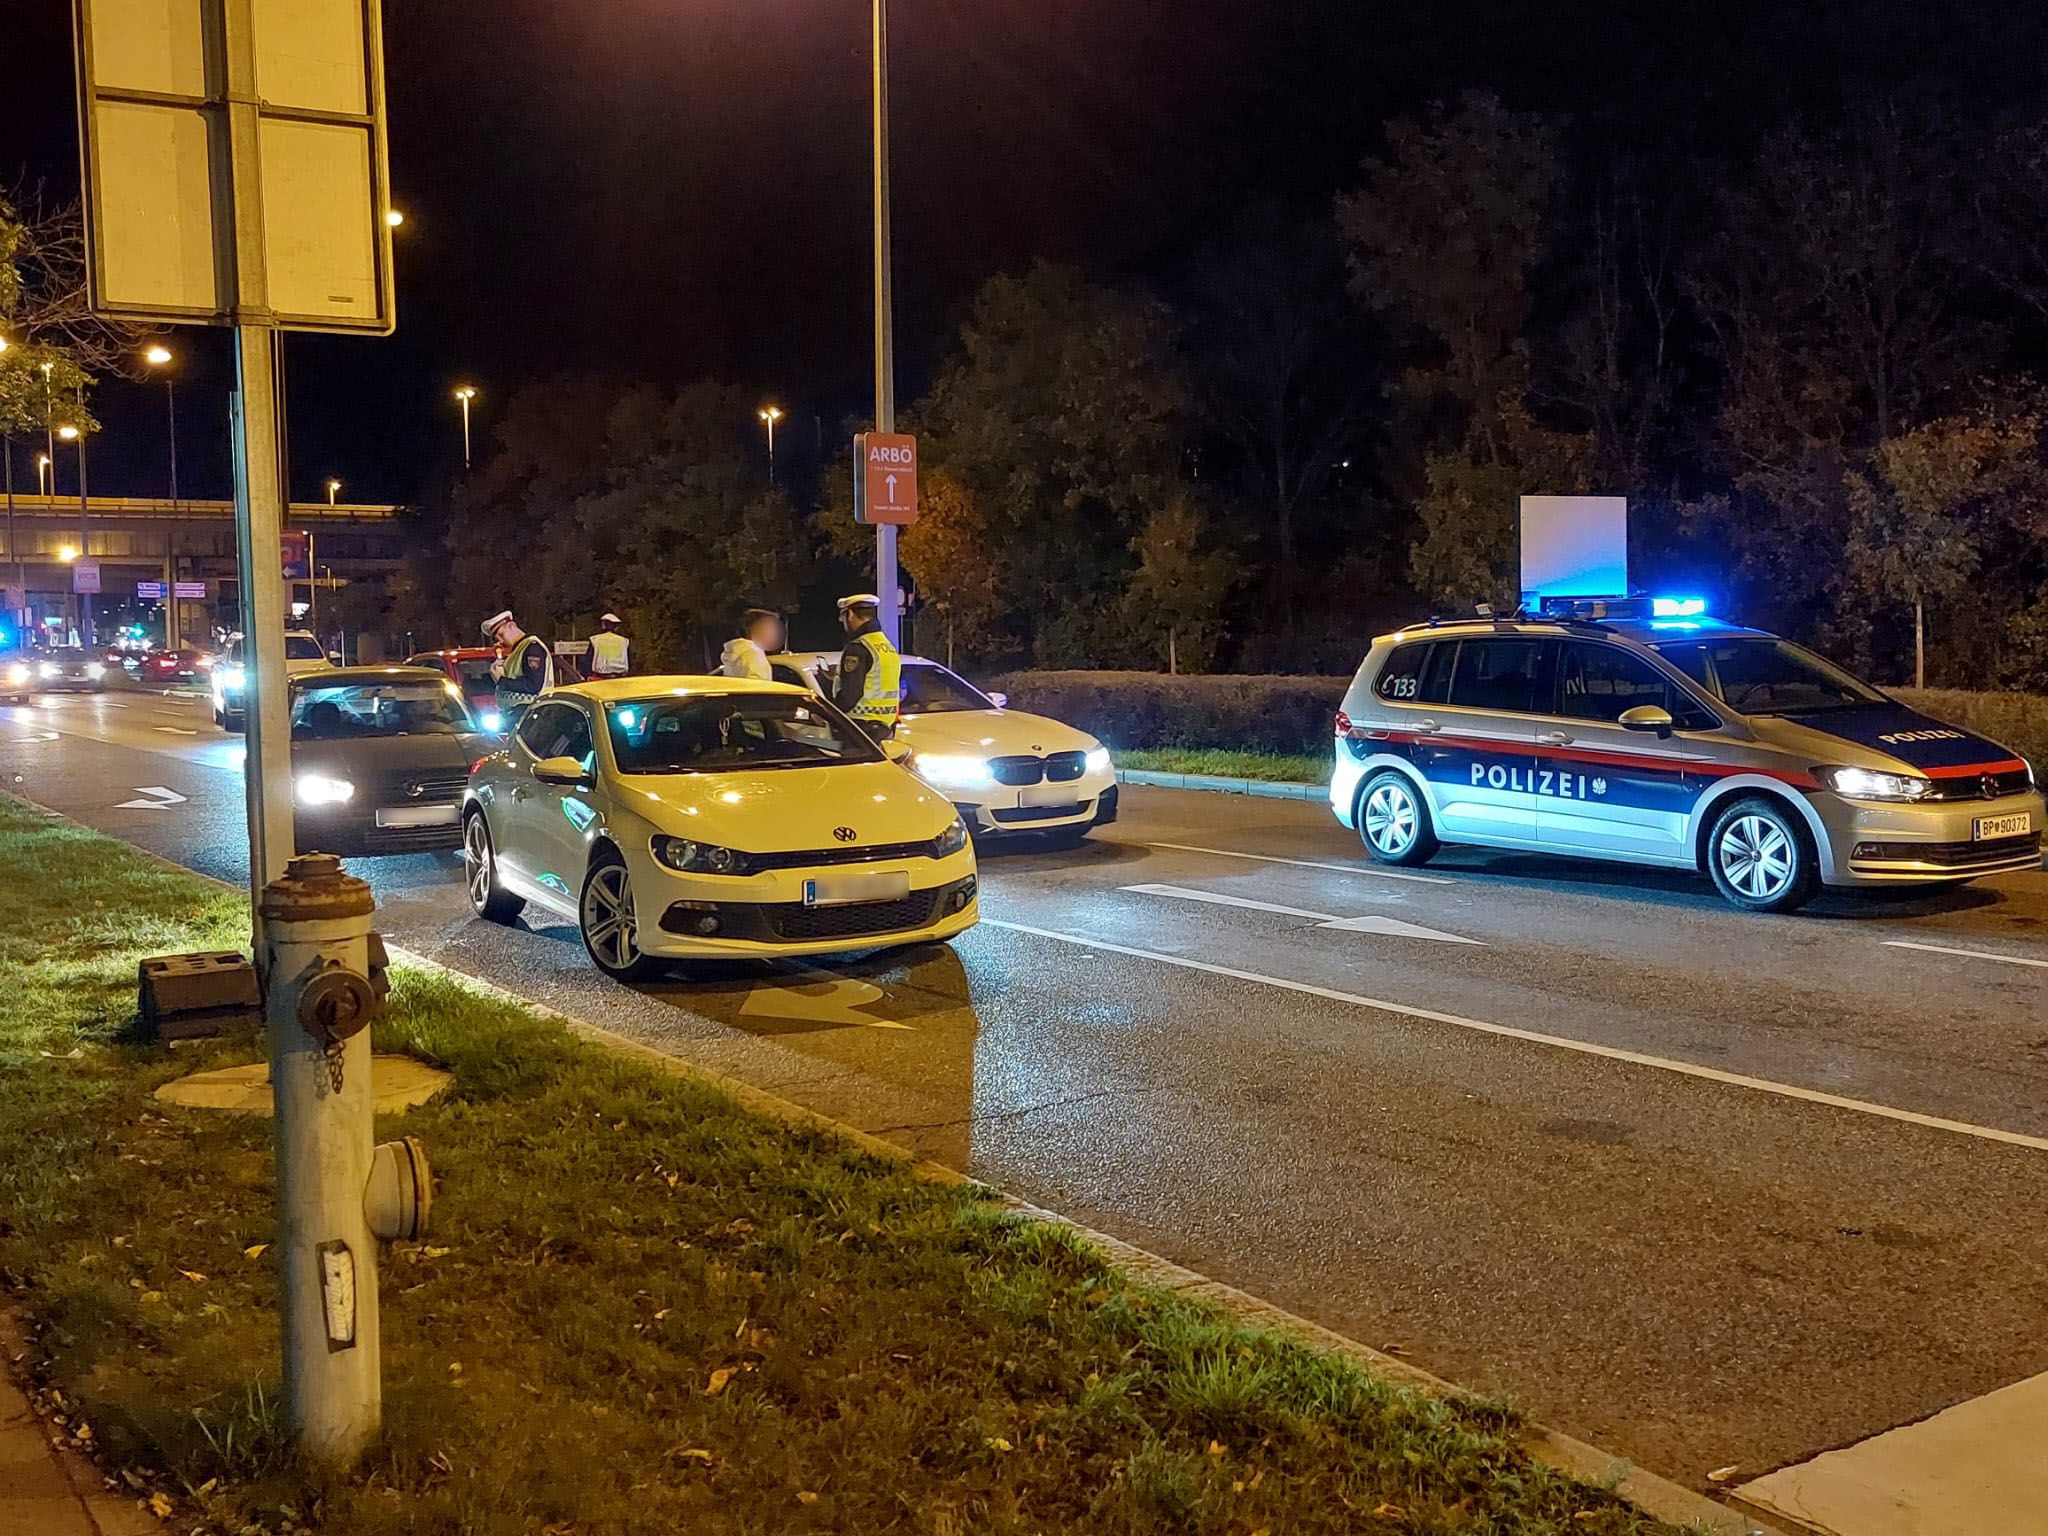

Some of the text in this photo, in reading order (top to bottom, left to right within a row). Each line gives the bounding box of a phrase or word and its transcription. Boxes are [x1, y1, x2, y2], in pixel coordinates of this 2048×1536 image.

[869, 444, 912, 463] ARBÖ
[1393, 678, 1417, 697] 133
[1878, 729, 1966, 744] POLIZEI
[1471, 763, 1586, 799] POLIZEI
